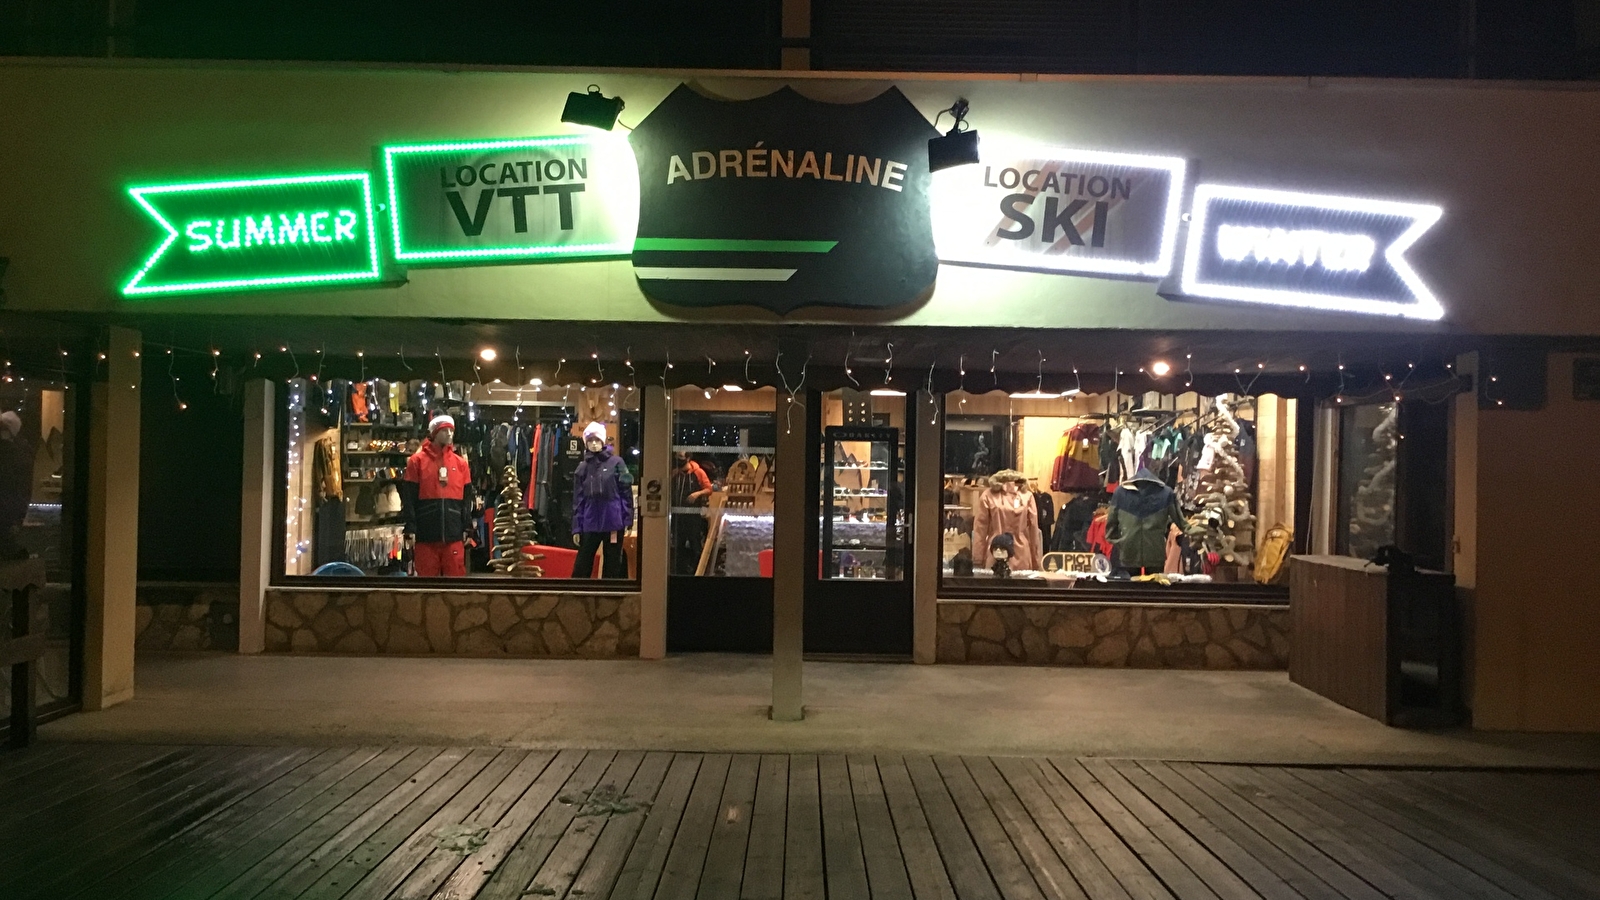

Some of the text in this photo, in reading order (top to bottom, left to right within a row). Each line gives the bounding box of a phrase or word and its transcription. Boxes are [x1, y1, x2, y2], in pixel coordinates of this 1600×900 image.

[440, 157, 588, 188] LOCATION
[666, 141, 908, 193] ADRÉNALINE
[984, 165, 1131, 200] LOCATION
[185, 209, 357, 252] SUMMER
[445, 182, 586, 237] VTT
[996, 193, 1109, 248] SKI
[1064, 554, 1093, 568] PICT
